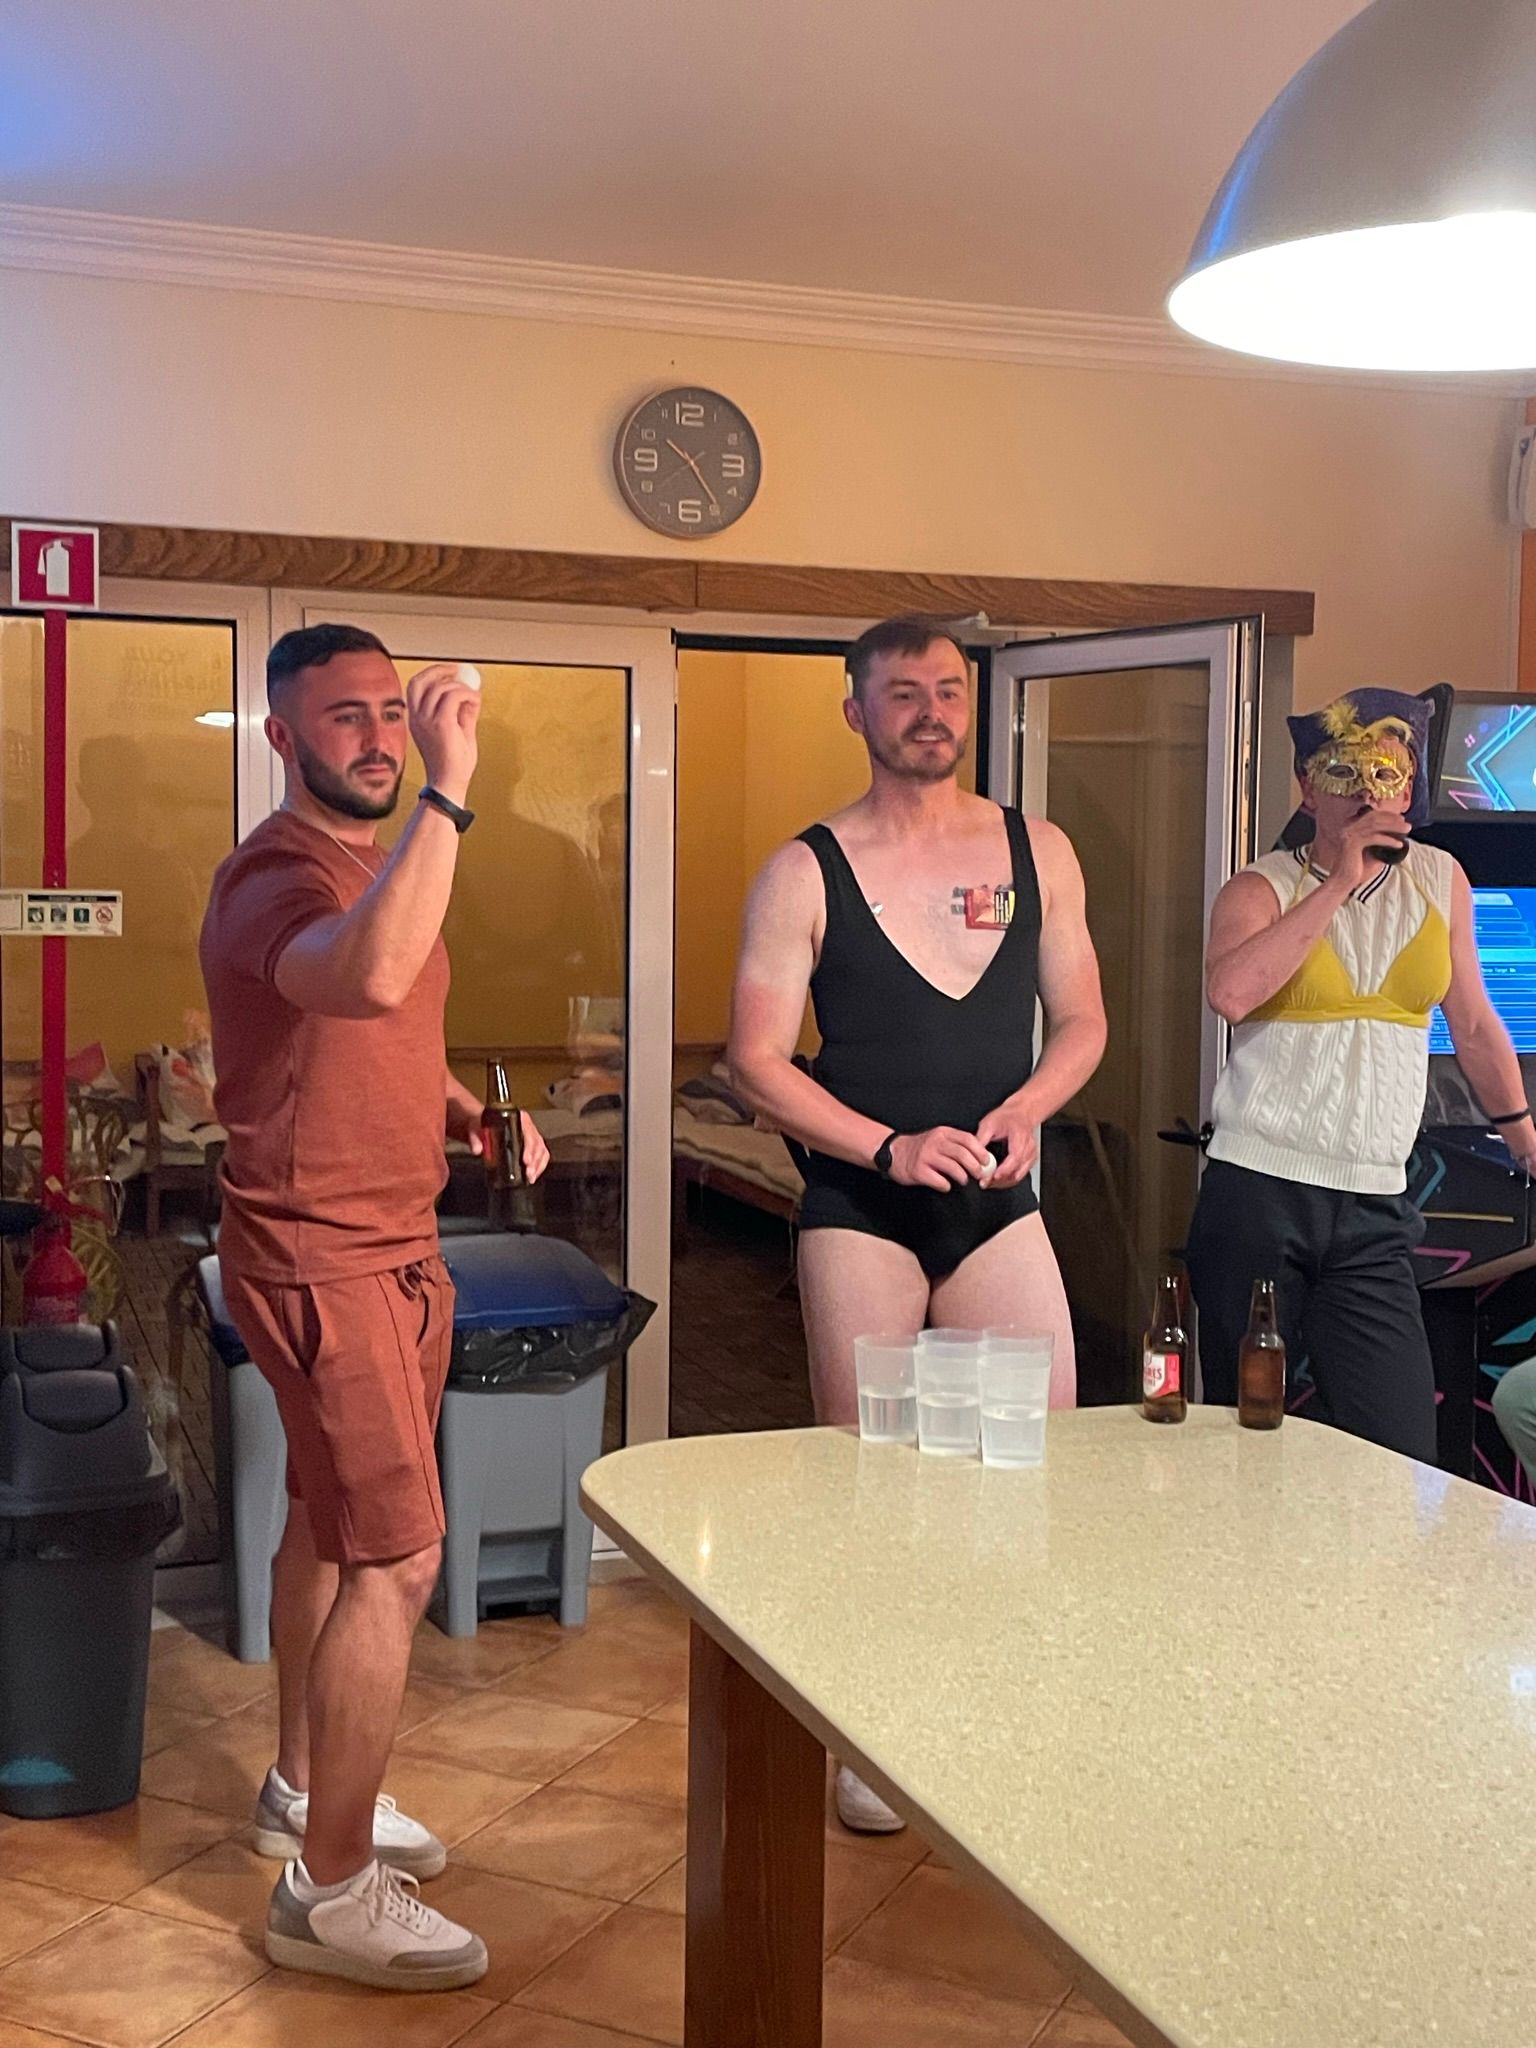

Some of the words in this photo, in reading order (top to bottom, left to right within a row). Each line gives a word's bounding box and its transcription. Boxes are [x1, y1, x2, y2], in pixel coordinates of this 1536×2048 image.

[675, 402, 705, 427] 12
[641, 428, 656, 441] 10
[634, 448, 658, 472] 9
[721, 453, 745, 478] 3
[678, 499, 702, 523] 6
